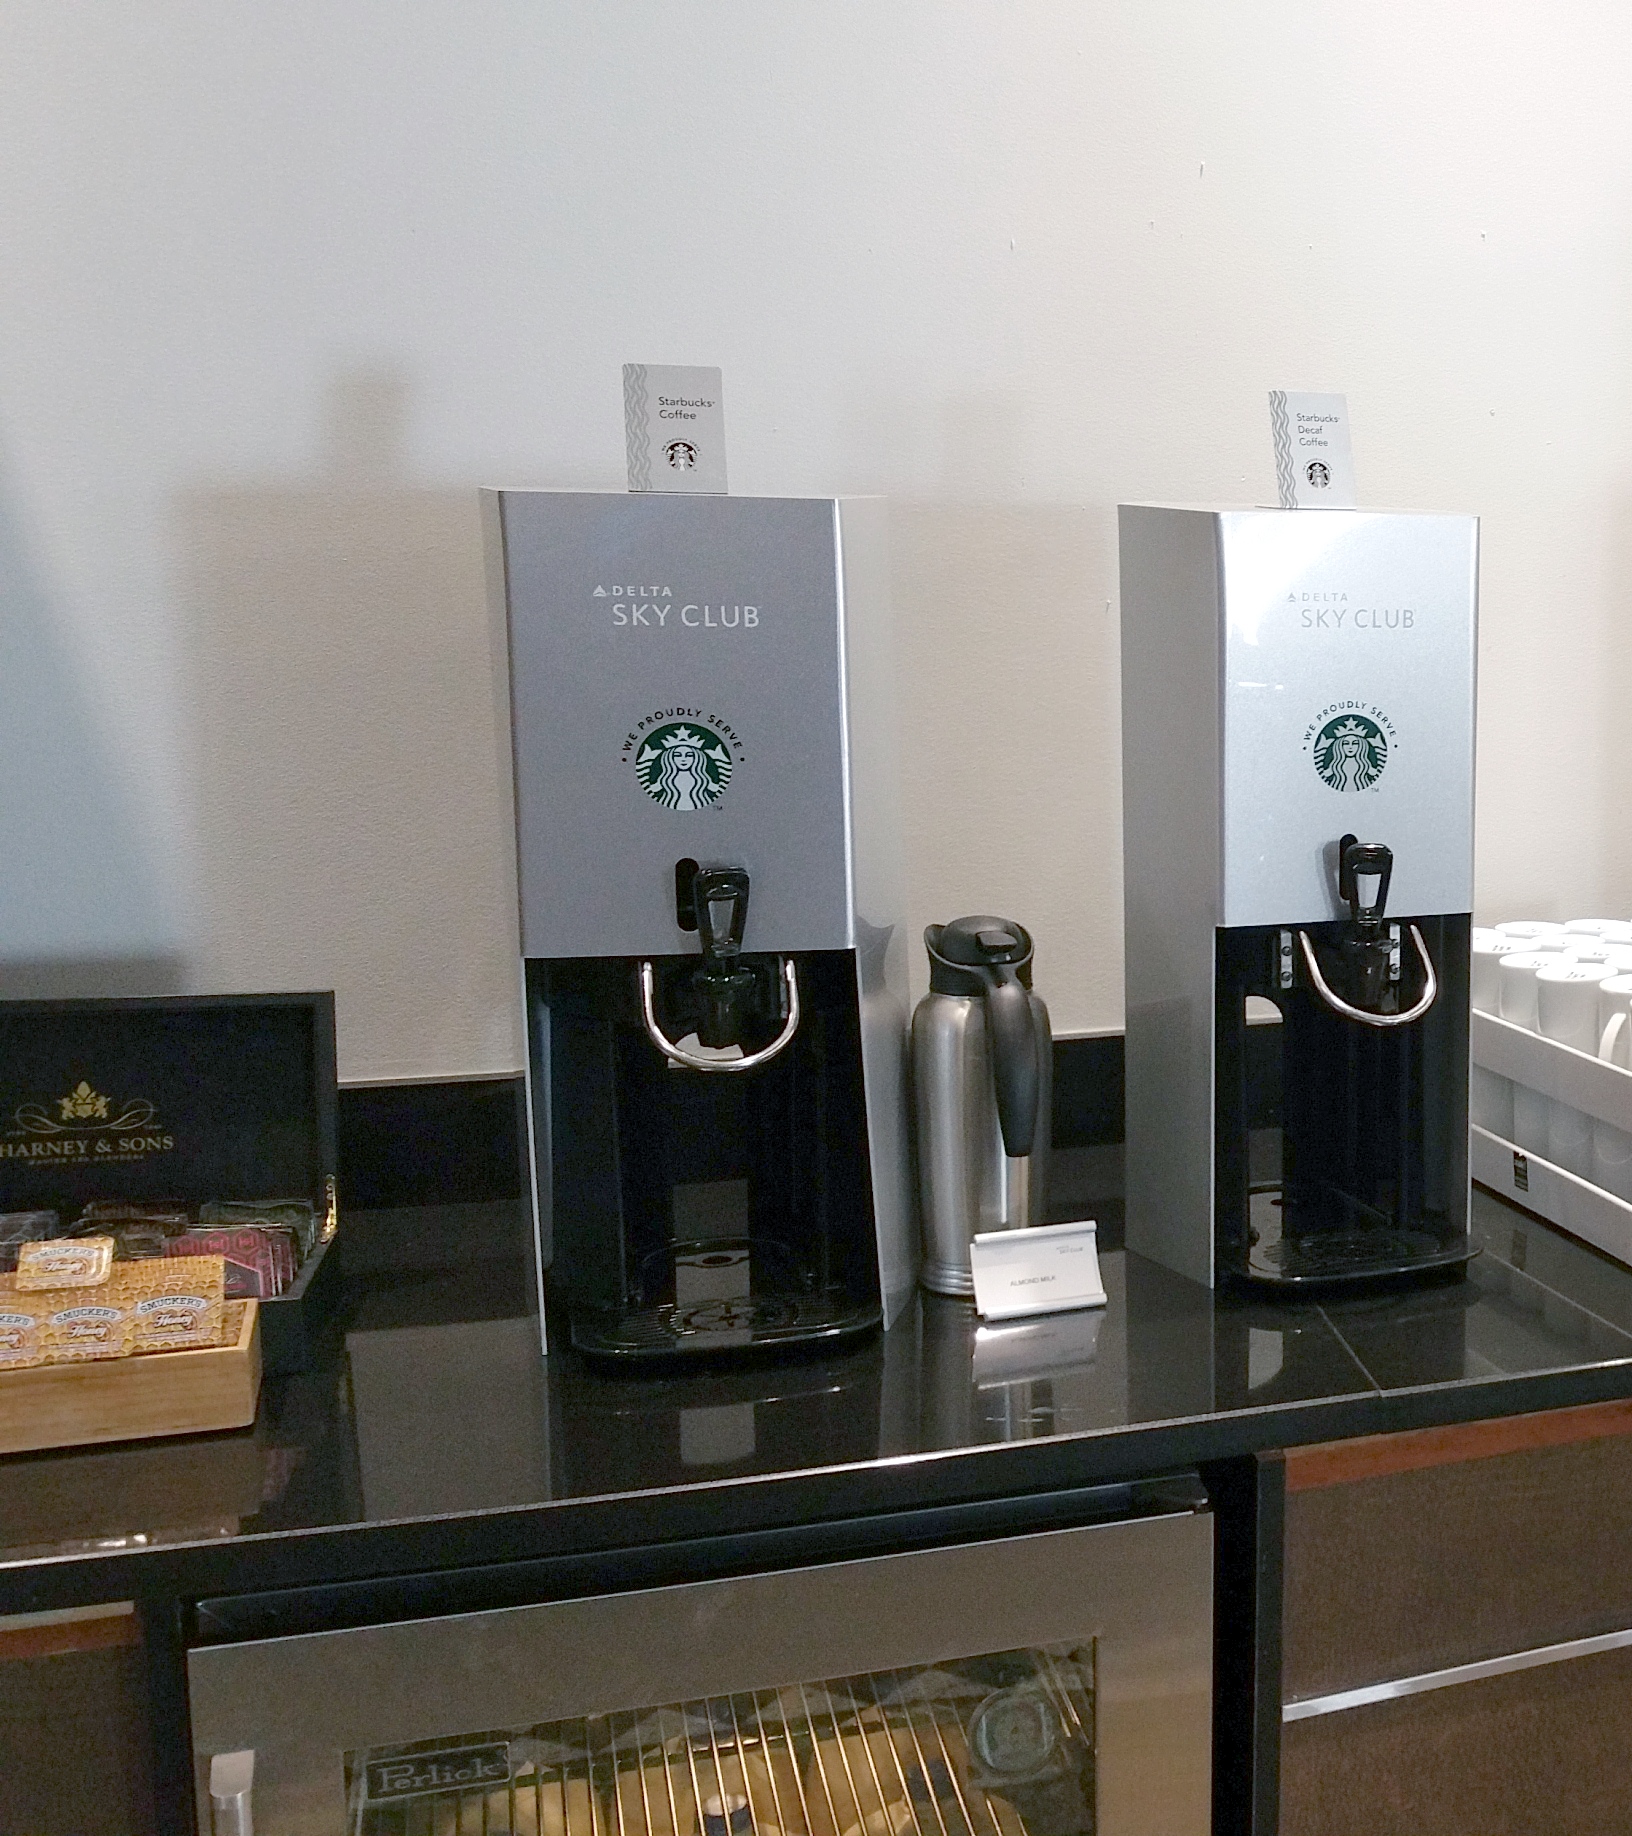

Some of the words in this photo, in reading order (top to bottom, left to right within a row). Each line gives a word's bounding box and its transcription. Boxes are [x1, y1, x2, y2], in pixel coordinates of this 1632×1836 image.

[658, 396, 713, 408] Starbucks
[659, 409, 697, 420] Coffee
[1296, 412, 1339, 423] Starbucks
[1298, 425, 1323, 434] Decaf
[1299, 437, 1329, 447] Coffee
[612, 585, 673, 597] DELTA
[1302, 592, 1349, 602] DELTA
[612, 603, 672, 626] SKY
[681, 604, 760, 628] CLUB
[1301, 608, 1348, 628] SKY
[1354, 609, 1416, 629] CLUB
[1303, 723, 1317, 741] WE
[1316, 700, 1367, 721] PROUDLY
[1370, 706, 1397, 738] SERVE
[622, 732, 639, 751] WE
[637, 707, 702, 730] PROUDLY
[707, 714, 743, 749] SERVE
[0, 1140, 89, 1158] HARNEY
[95, 1138, 111, 1153] &
[118, 1136, 174, 1151] SONS
[376, 1757, 503, 1794] Perlick
